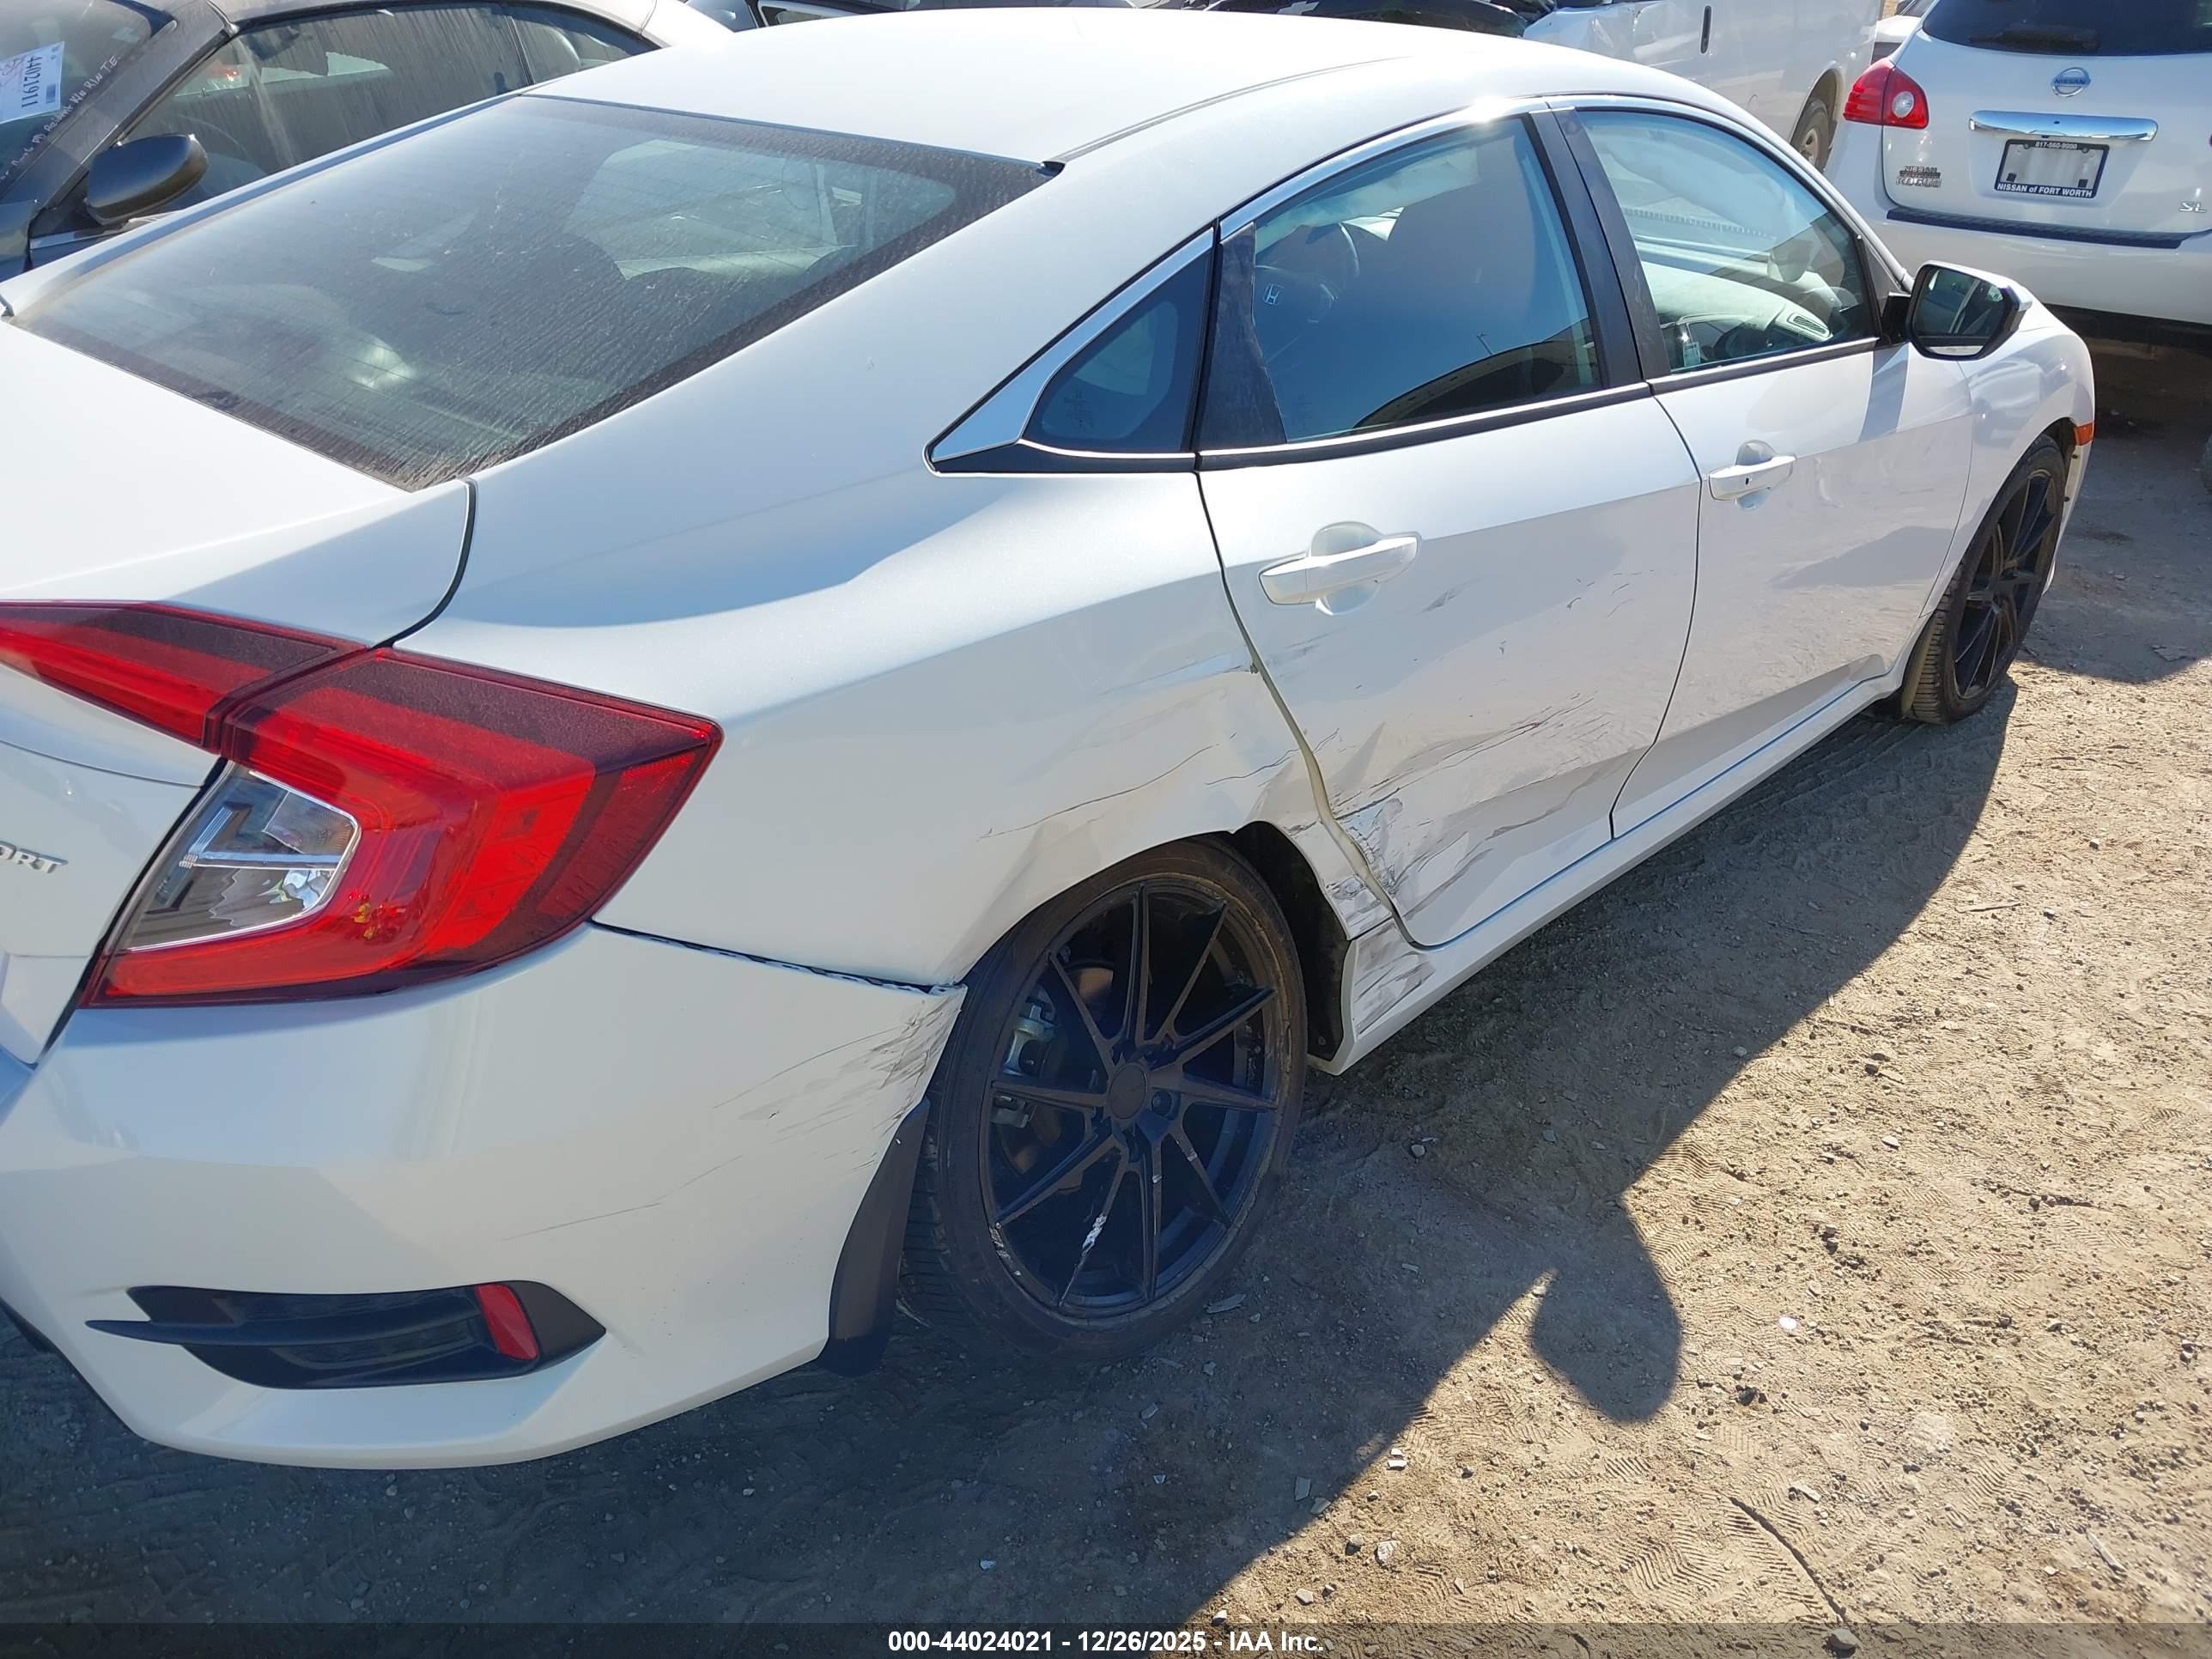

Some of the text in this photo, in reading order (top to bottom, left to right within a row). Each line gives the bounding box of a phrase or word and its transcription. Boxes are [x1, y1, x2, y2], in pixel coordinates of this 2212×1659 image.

[21, 56, 42, 108] 44021911
[1997, 183, 2027, 193] NISSAN
[2038, 186, 2060, 195] FORT
[2062, 188, 2093, 198] WORTH
[2179, 201, 2207, 214] SL
